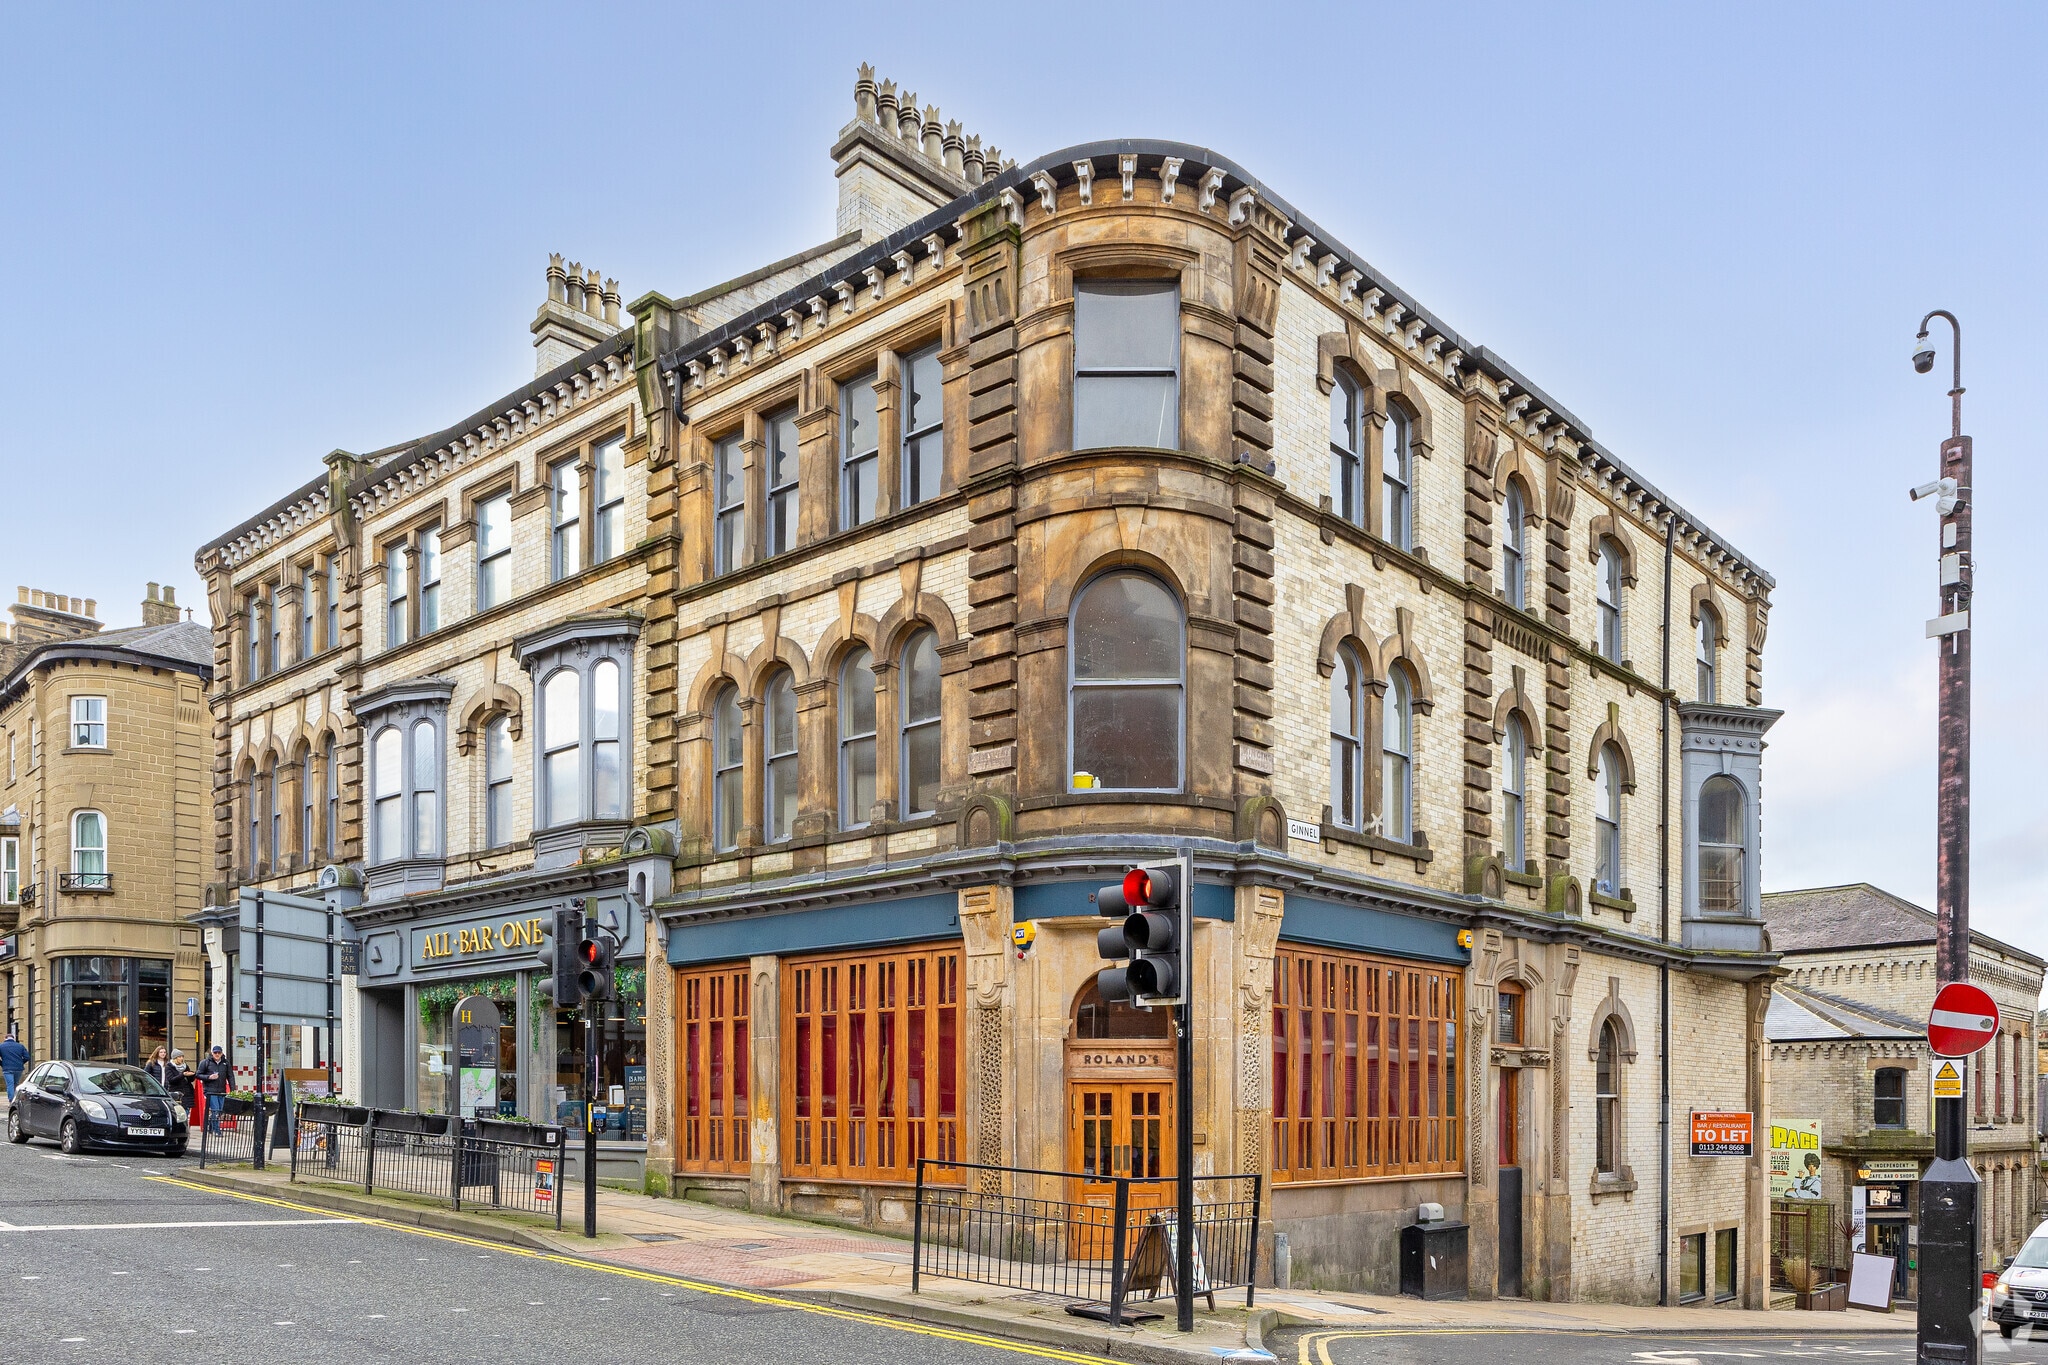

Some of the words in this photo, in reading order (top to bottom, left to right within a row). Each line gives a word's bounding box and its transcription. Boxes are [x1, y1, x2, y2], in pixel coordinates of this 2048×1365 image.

[1291, 823, 1318, 839] GINNEL
[422, 933, 453, 959] ALL
[458, 925, 494, 954] BAR
[500, 917, 544, 948] ONE
[461, 1009, 473, 1024] H
[1177, 1028, 1184, 1037] 3
[1083, 1054, 1160, 1065] ROLAND'S
[131, 1127, 148, 1135] YY58
[149, 1128, 162, 1136] TCV
[1695, 1129, 1717, 1142] TO
[1721, 1129, 1749, 1142] LET
